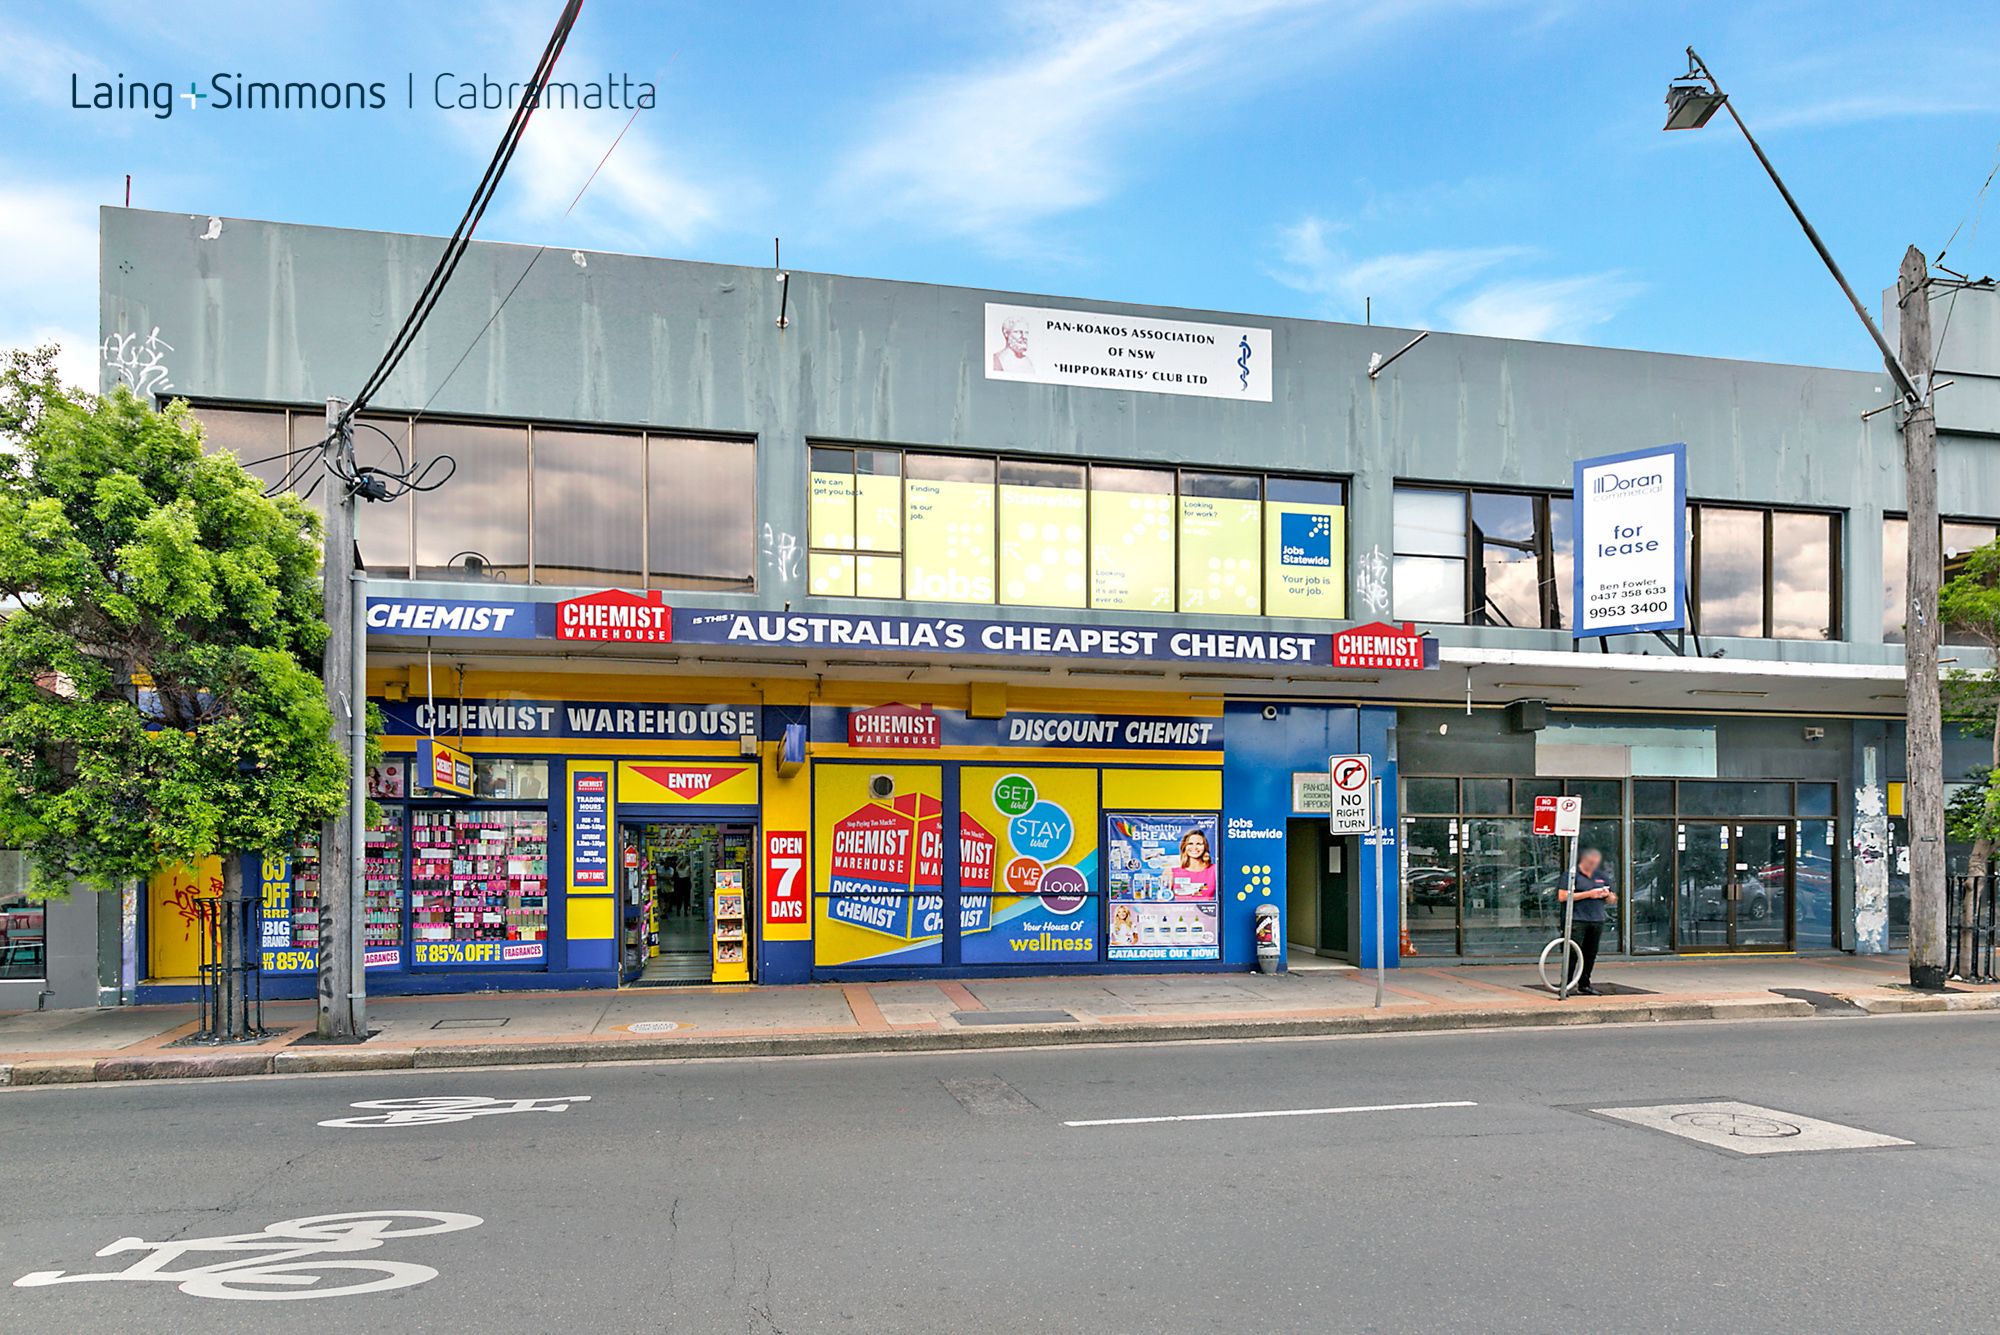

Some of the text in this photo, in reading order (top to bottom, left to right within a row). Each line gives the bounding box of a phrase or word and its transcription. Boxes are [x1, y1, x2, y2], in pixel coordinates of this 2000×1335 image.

[1046, 320, 1215, 345] PAN-KOAKOS ASSOCIATION
[1108, 347, 1155, 359] OF NSW
[1152, 371, 1183, 383] CLUB
[1186, 374, 1208, 385] LTD
[910, 485, 940, 494] Finding
[1184, 501, 1213, 510] Looking
[1184, 509, 1218, 518] for work?
[1614, 525, 1643, 539] for
[1283, 545, 1304, 555] Jobs
[1599, 540, 1659, 557] lease
[1283, 554, 1329, 566] Statewide
[1282, 575, 1331, 587] Your job is
[1600, 579, 1657, 591] Ben Fowler
[1288, 585, 1324, 596] our job.
[1591, 586, 1666, 601] 0437 358 633
[563, 603, 665, 628] CHEMIST
[1589, 601, 1667, 618] 9953 3400
[366, 604, 514, 631] CHEMIST
[564, 627, 666, 641] WAREHOUSE
[727, 615, 1316, 661] AUSTRALIA'S CHEAPEST CHEMIST
[1338, 634, 1418, 657] CHEMIST
[1339, 656, 1419, 667] WAREHOUSE
[415, 704, 755, 735] CHEMIST WAREHOUSE
[855, 714, 936, 734] CHEMIST
[1009, 718, 1213, 744] DISCOUNT CHEMIST
[856, 735, 936, 745] WAREHOUSE
[668, 773, 712, 789] ENTRY
[997, 785, 1032, 801] GET
[1341, 794, 1362, 806] NO
[1011, 801, 1028, 810] Well
[1336, 809, 1365, 817] RIGHT
[1016, 818, 1066, 840] STAY
[1141, 823, 1181, 834] Healthy
[1228, 818, 1253, 828] Jobs
[1339, 820, 1365, 828] TURN
[1132, 831, 1177, 841] BREAK
[1228, 828, 1283, 838] Statewide
[771, 837, 802, 854] OPEN
[835, 829, 909, 856] CHEMIST
[1030, 839, 1048, 848] Well
[834, 856, 904, 873] WAREHOUSE
[771, 858, 802, 897] 7
[1010, 866, 1040, 880] LIVE
[1044, 881, 1082, 893] LOOK
[262, 882, 290, 908] OFF
[771, 900, 802, 918] DAYS
[836, 900, 896, 929] CHEMIST
[263, 921, 290, 936] BIG
[1023, 921, 1084, 931] Your House Of
[262, 936, 290, 948] BRANDS
[1009, 933, 1093, 951] wellness
[416, 945, 426, 954] UP
[416, 954, 426, 963] TO
[429, 944, 463, 962] 85%
[465, 944, 493, 961] OFF
[505, 946, 541, 957] FRAGRANCES
[1108, 949, 1218, 959] CATALOGUE OUT NOW!
[262, 953, 275, 961] UP
[262, 961, 274, 970] TO
[276, 952, 314, 970] 85%
[365, 951, 398, 964] AGRANCES
